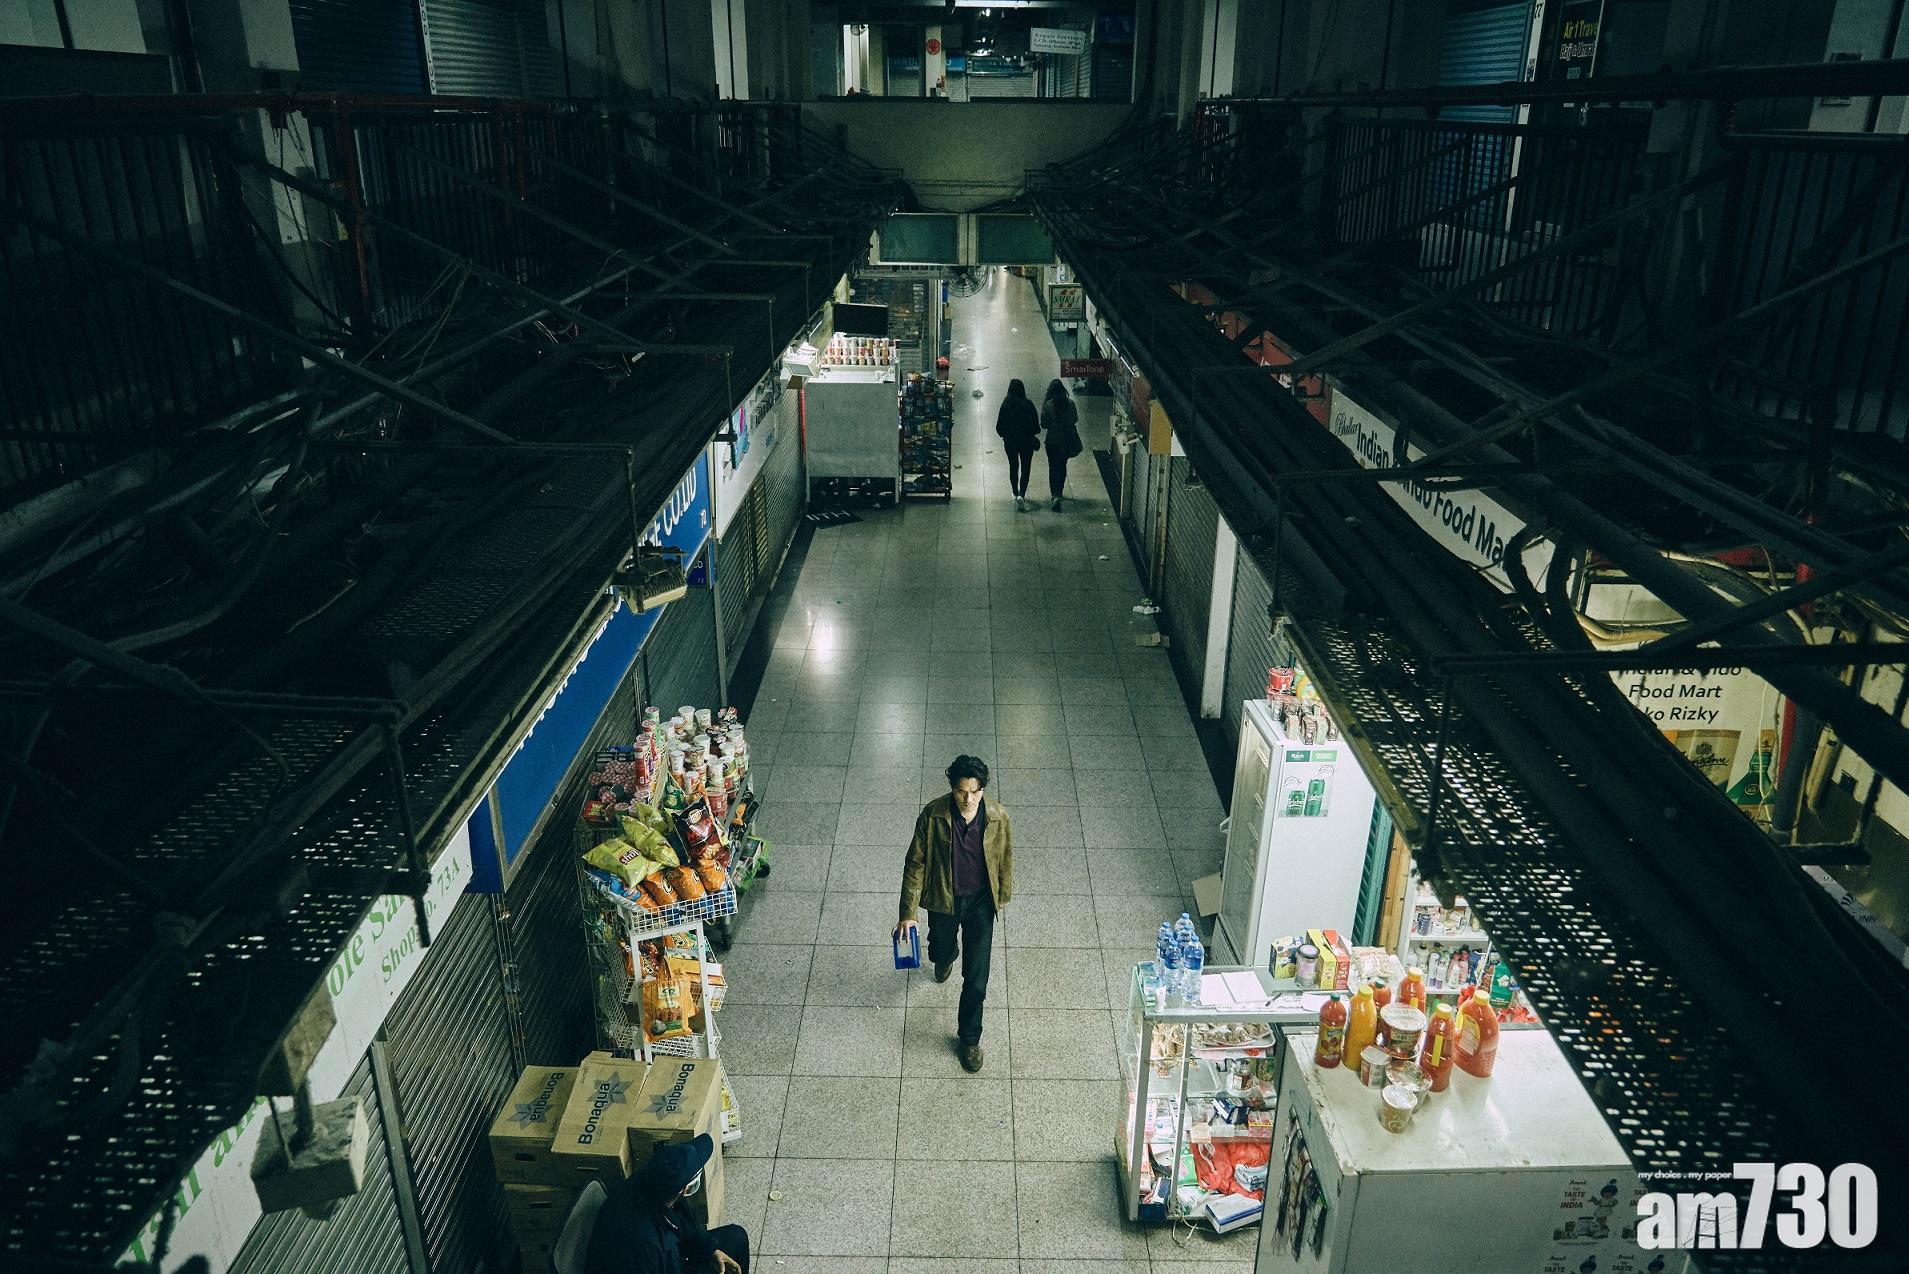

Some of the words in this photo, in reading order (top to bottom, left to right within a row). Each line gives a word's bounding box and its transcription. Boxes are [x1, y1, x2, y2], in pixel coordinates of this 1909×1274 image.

[1357, 423, 1389, 468] Indian
[1434, 491, 1476, 543] Food
[1475, 515, 1505, 568] Ma
[1629, 684, 1674, 698] Food
[1679, 685, 1722, 698] Mart
[1670, 706, 1719, 724] Rizky
[382, 926, 417, 984] Shop
[425, 900, 437, 918] o.
[437, 857, 460, 898] 73A
[529, 1072, 564, 1121] Bonaqua
[665, 1063, 695, 1113] Bonaqua
[578, 1082, 611, 1145] Bonaqua
